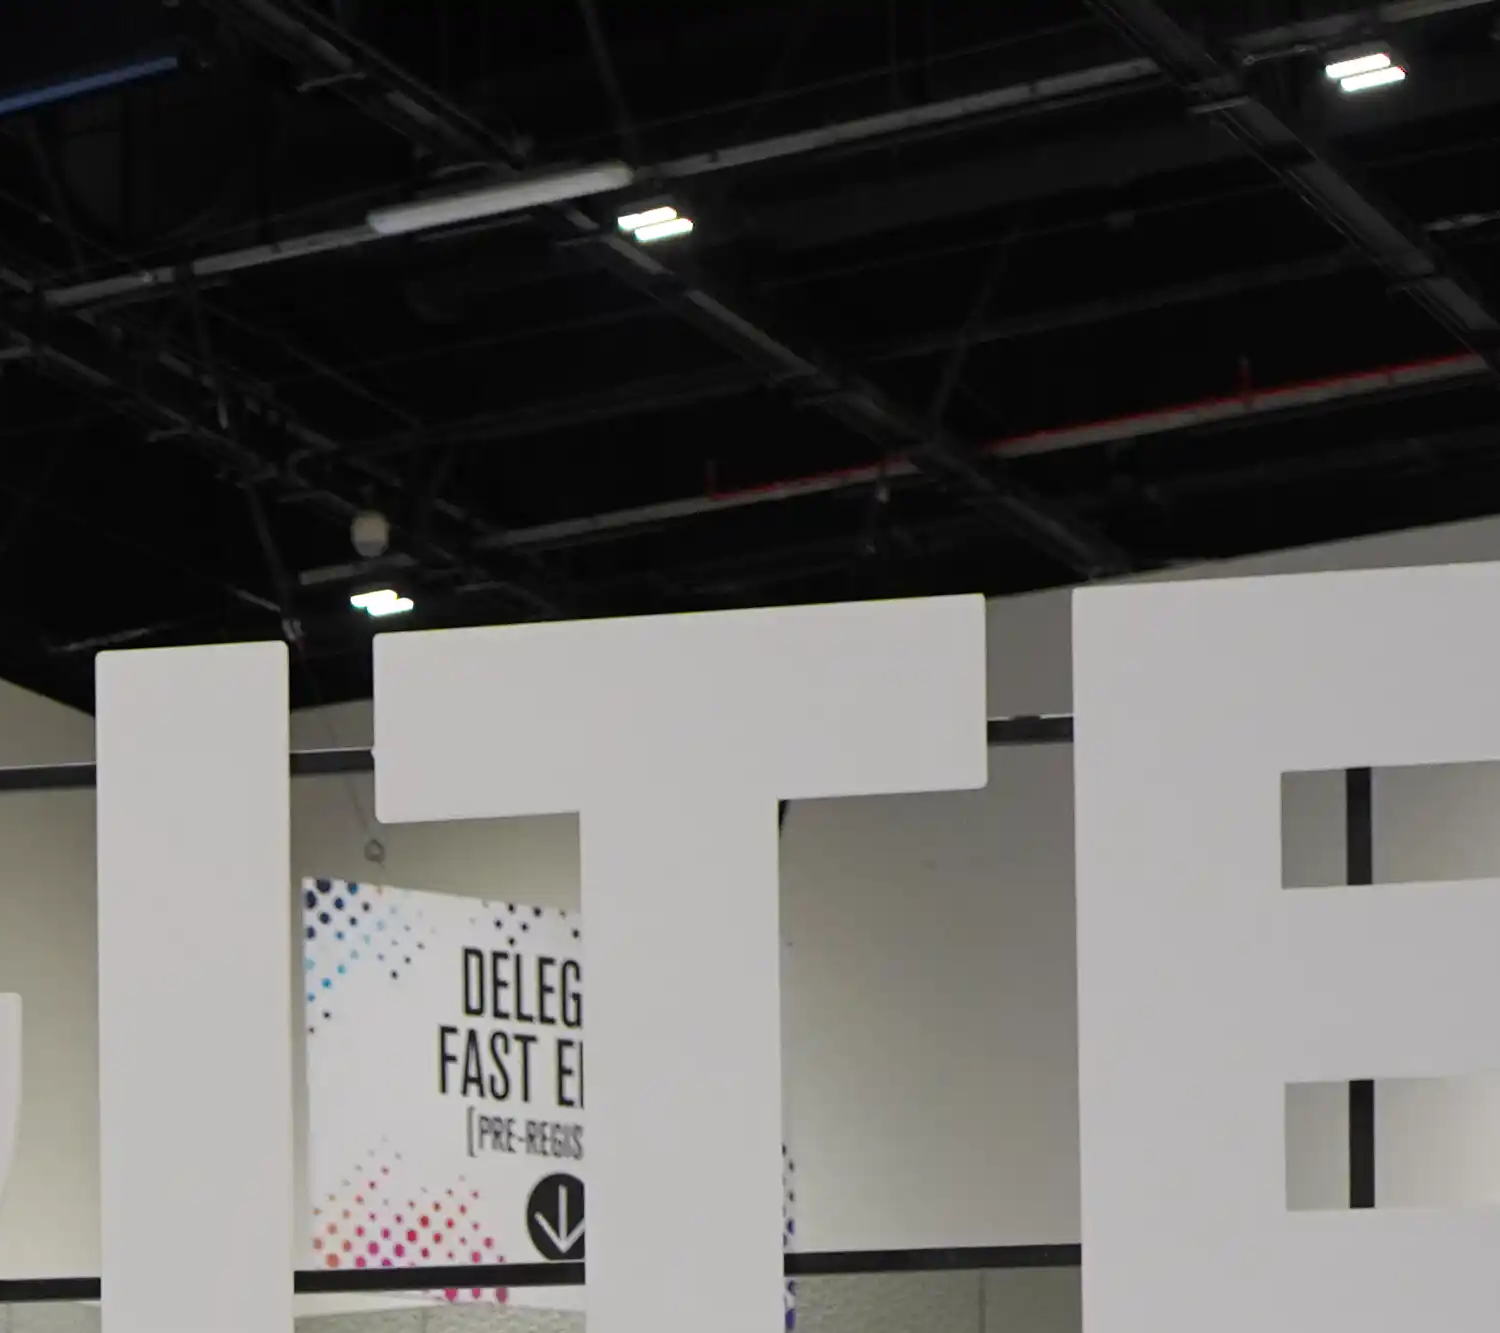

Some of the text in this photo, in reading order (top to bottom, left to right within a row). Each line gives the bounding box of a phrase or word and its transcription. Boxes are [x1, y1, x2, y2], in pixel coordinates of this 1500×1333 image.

[462, 946, 582, 1030] DELEG
[438, 1024, 584, 1110] FAST E
